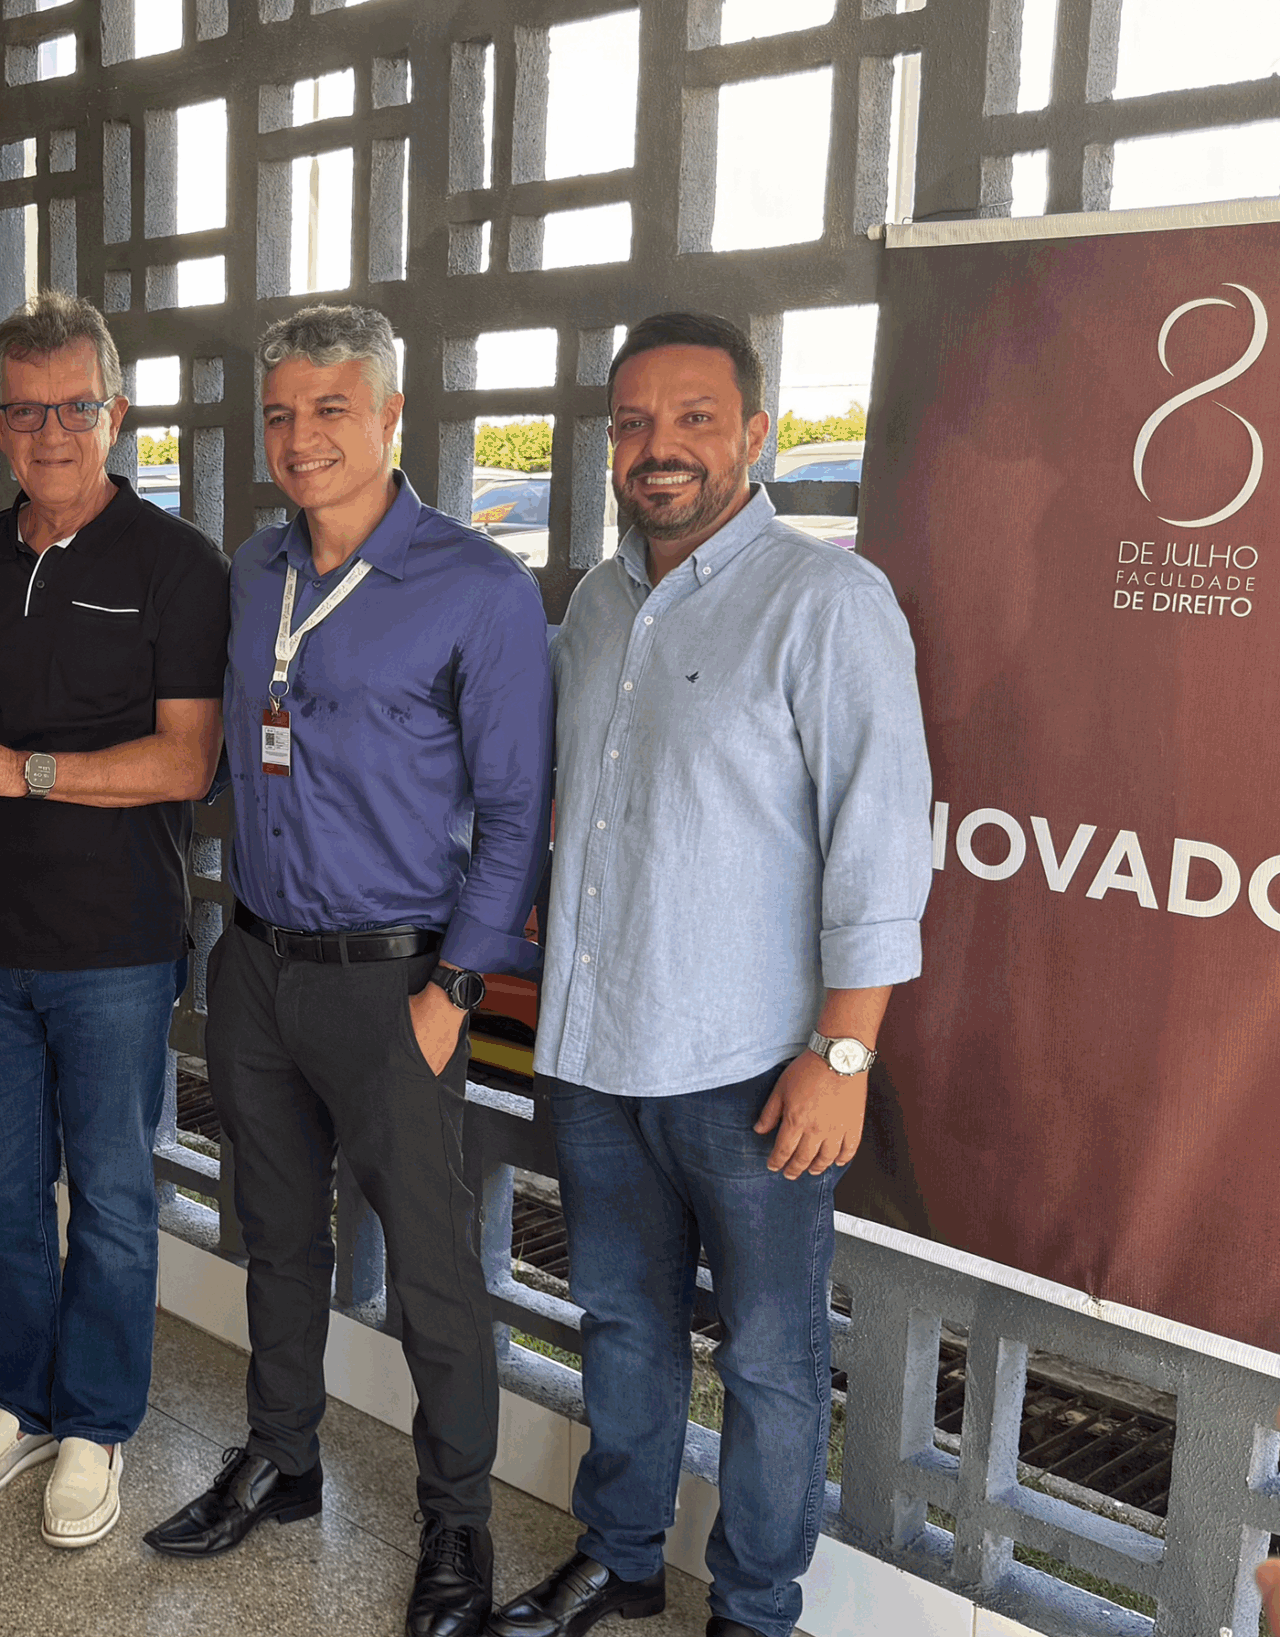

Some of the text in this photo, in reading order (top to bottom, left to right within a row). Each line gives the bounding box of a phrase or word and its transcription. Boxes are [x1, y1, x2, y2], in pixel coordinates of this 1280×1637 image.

[1118, 540, 1259, 570] DE JULHO
[1116, 570, 1256, 592] FACULDADE
[1113, 589, 1252, 618] DE DIREITO
